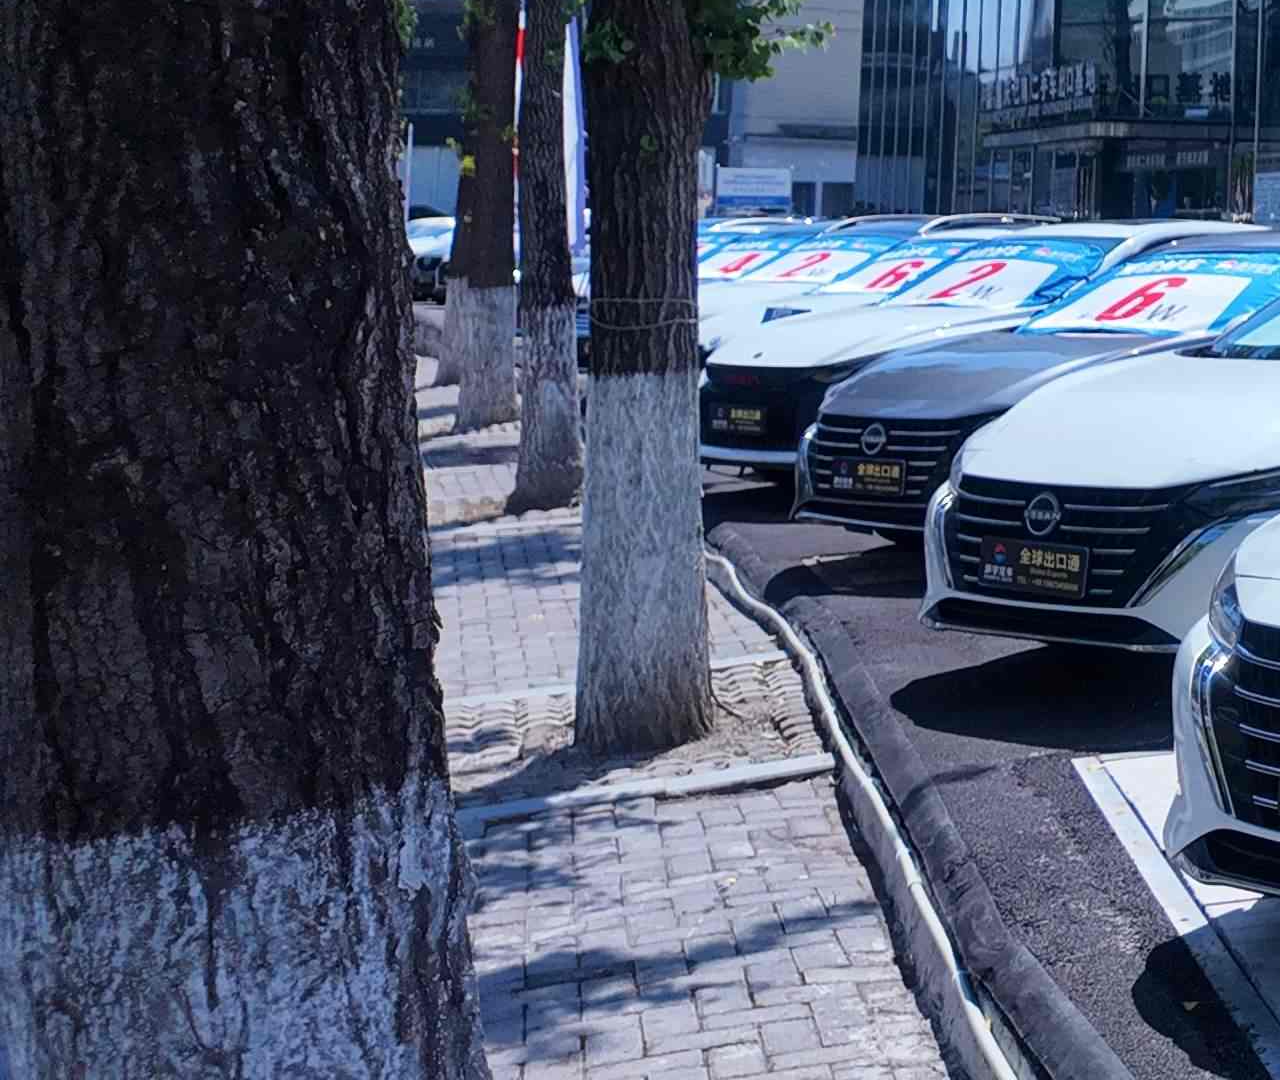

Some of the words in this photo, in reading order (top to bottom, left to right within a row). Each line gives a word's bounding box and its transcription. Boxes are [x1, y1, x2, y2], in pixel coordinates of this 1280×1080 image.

[928, 262, 1008, 299] 2
[1095, 277, 1187, 322] 6
[1147, 304, 1188, 321] W
